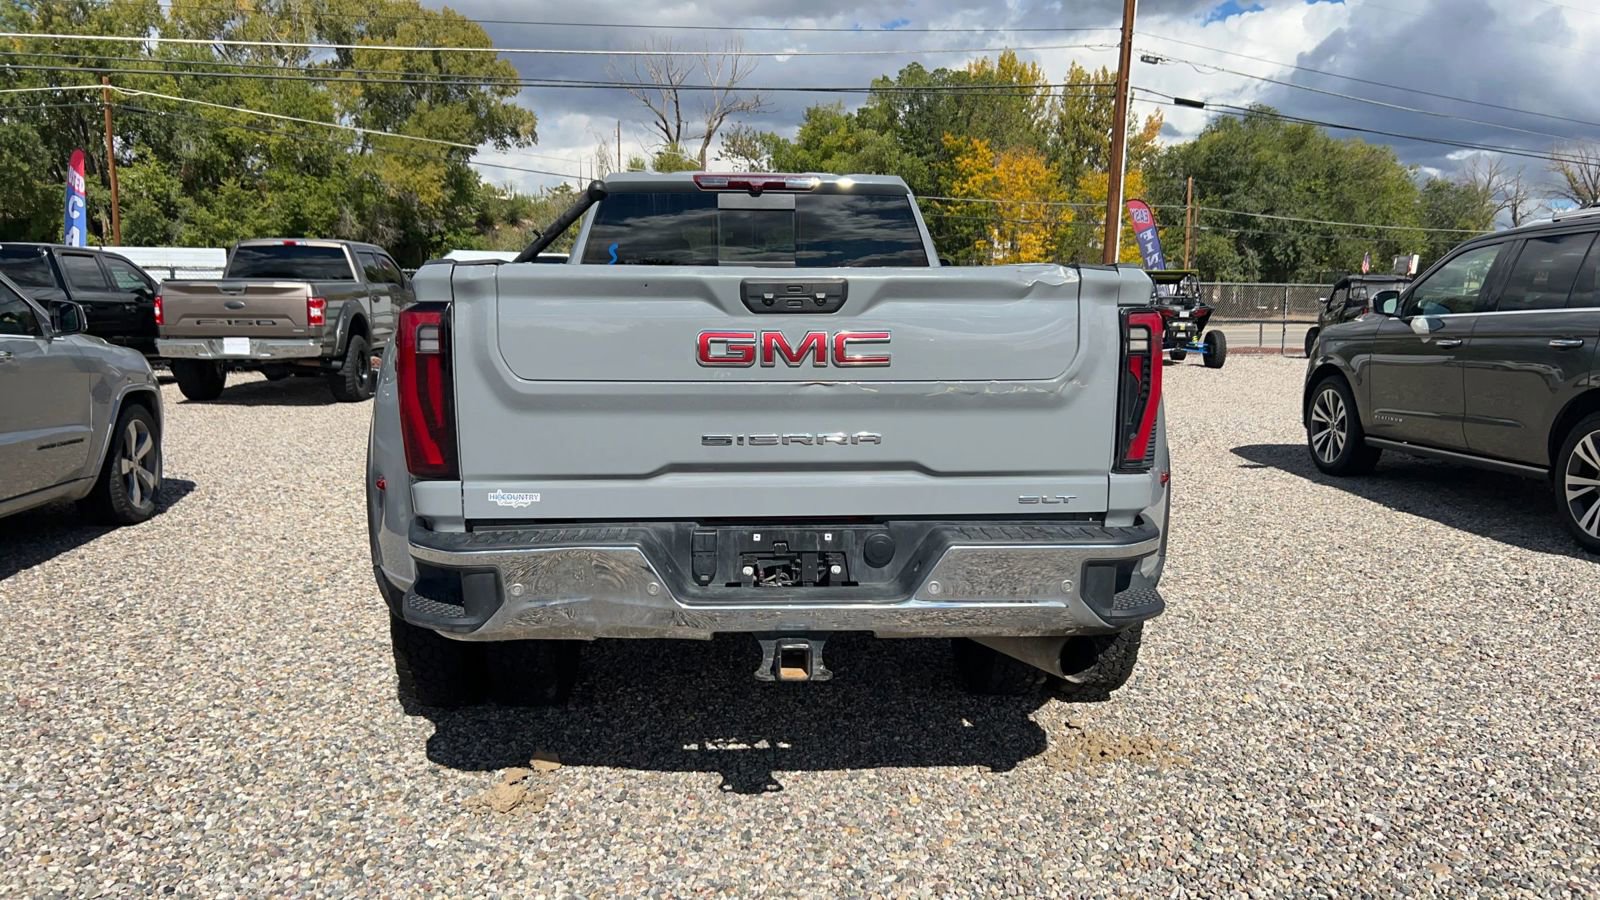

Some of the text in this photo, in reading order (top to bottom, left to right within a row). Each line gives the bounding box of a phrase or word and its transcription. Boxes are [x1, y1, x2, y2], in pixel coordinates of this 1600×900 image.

[695, 329, 892, 368] GMC
[701, 431, 882, 447] SIERRA
[1018, 495, 1077, 505] SLT
